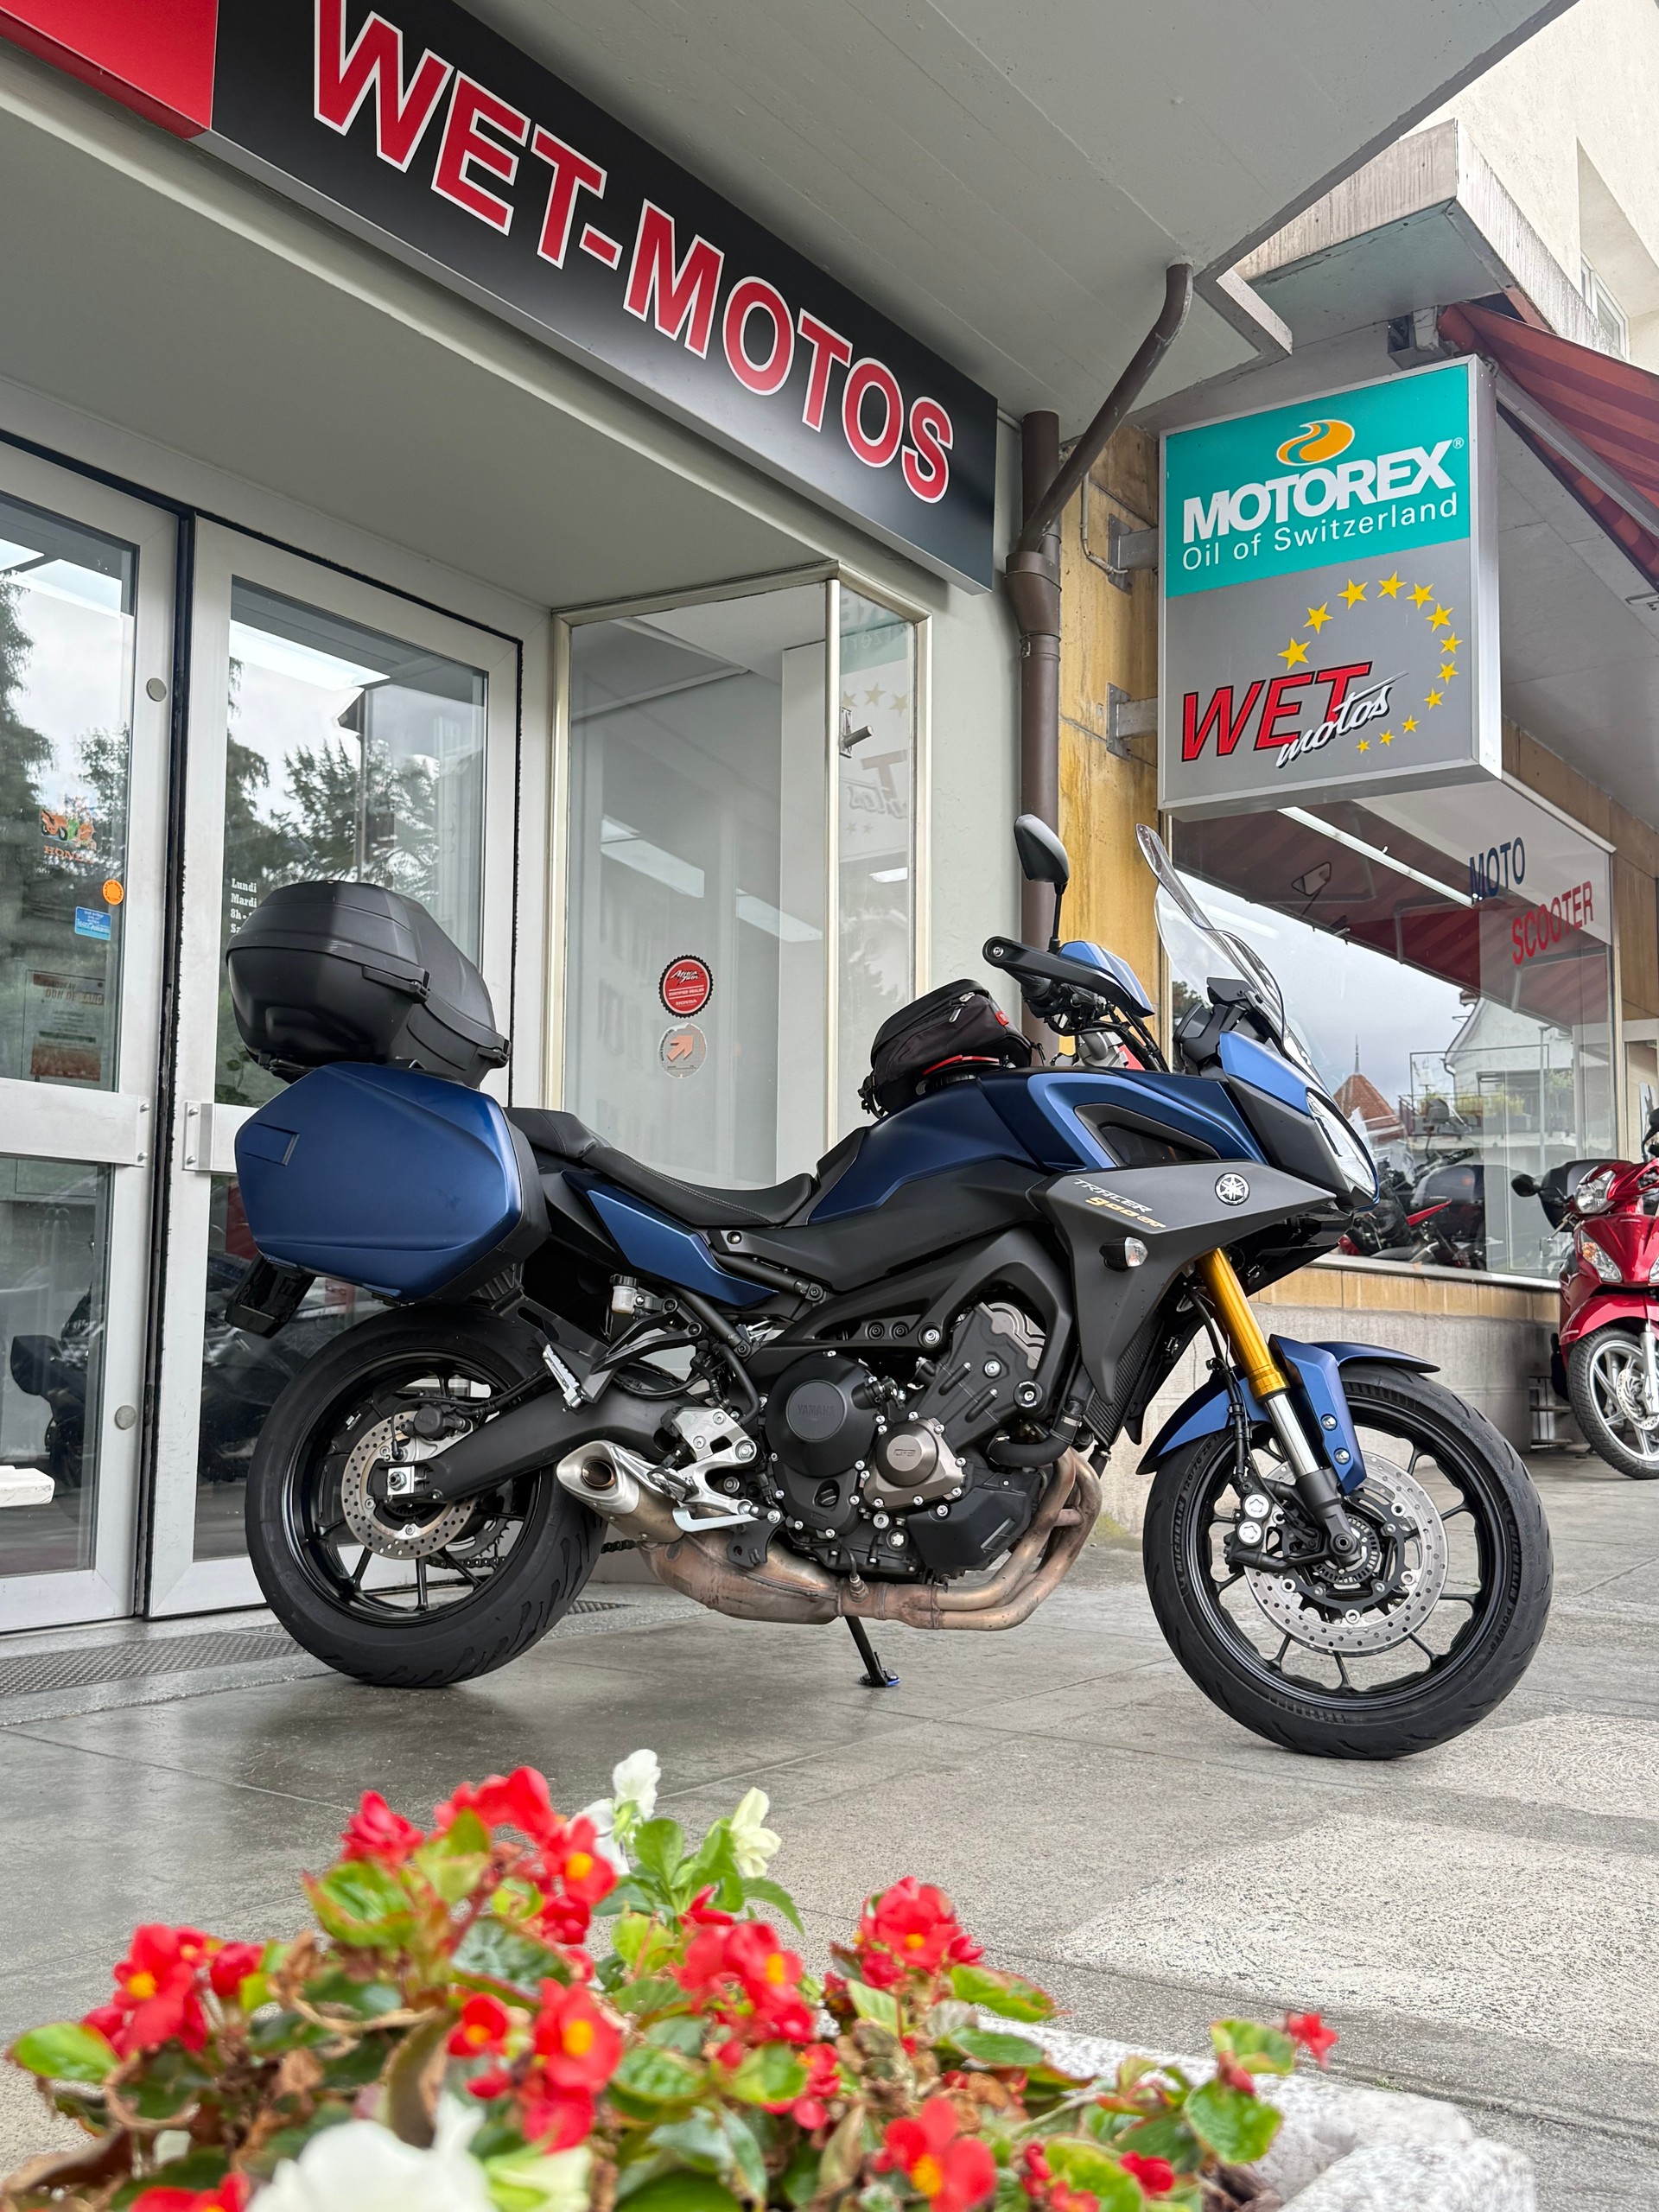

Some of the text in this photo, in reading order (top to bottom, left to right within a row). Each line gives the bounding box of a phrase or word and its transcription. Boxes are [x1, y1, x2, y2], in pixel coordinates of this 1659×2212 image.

[315, 0, 953, 503] WET-MOTOS
[1183, 439, 1456, 543] MOTOREX
[1183, 492, 1457, 570] Oil of Switzerland
[1181, 661, 1374, 762] WET
[1275, 671, 1408, 768] motos
[231, 893, 257, 908] Mardi
[232, 878, 257, 893] Lundi
[1470, 836, 1526, 905] MOTO
[230, 908, 242, 920] 8h
[1512, 880, 1594, 965] SCOOTER
[1073, 1178, 1153, 1212] TRACER
[797, 1404, 836, 1417] YAMAHA
[1173, 1499, 1185, 1573] MICHELIN
[1183, 1457, 1203, 1493] 120/70
[1489, 1523, 1522, 1653] MICHELIN POWER
